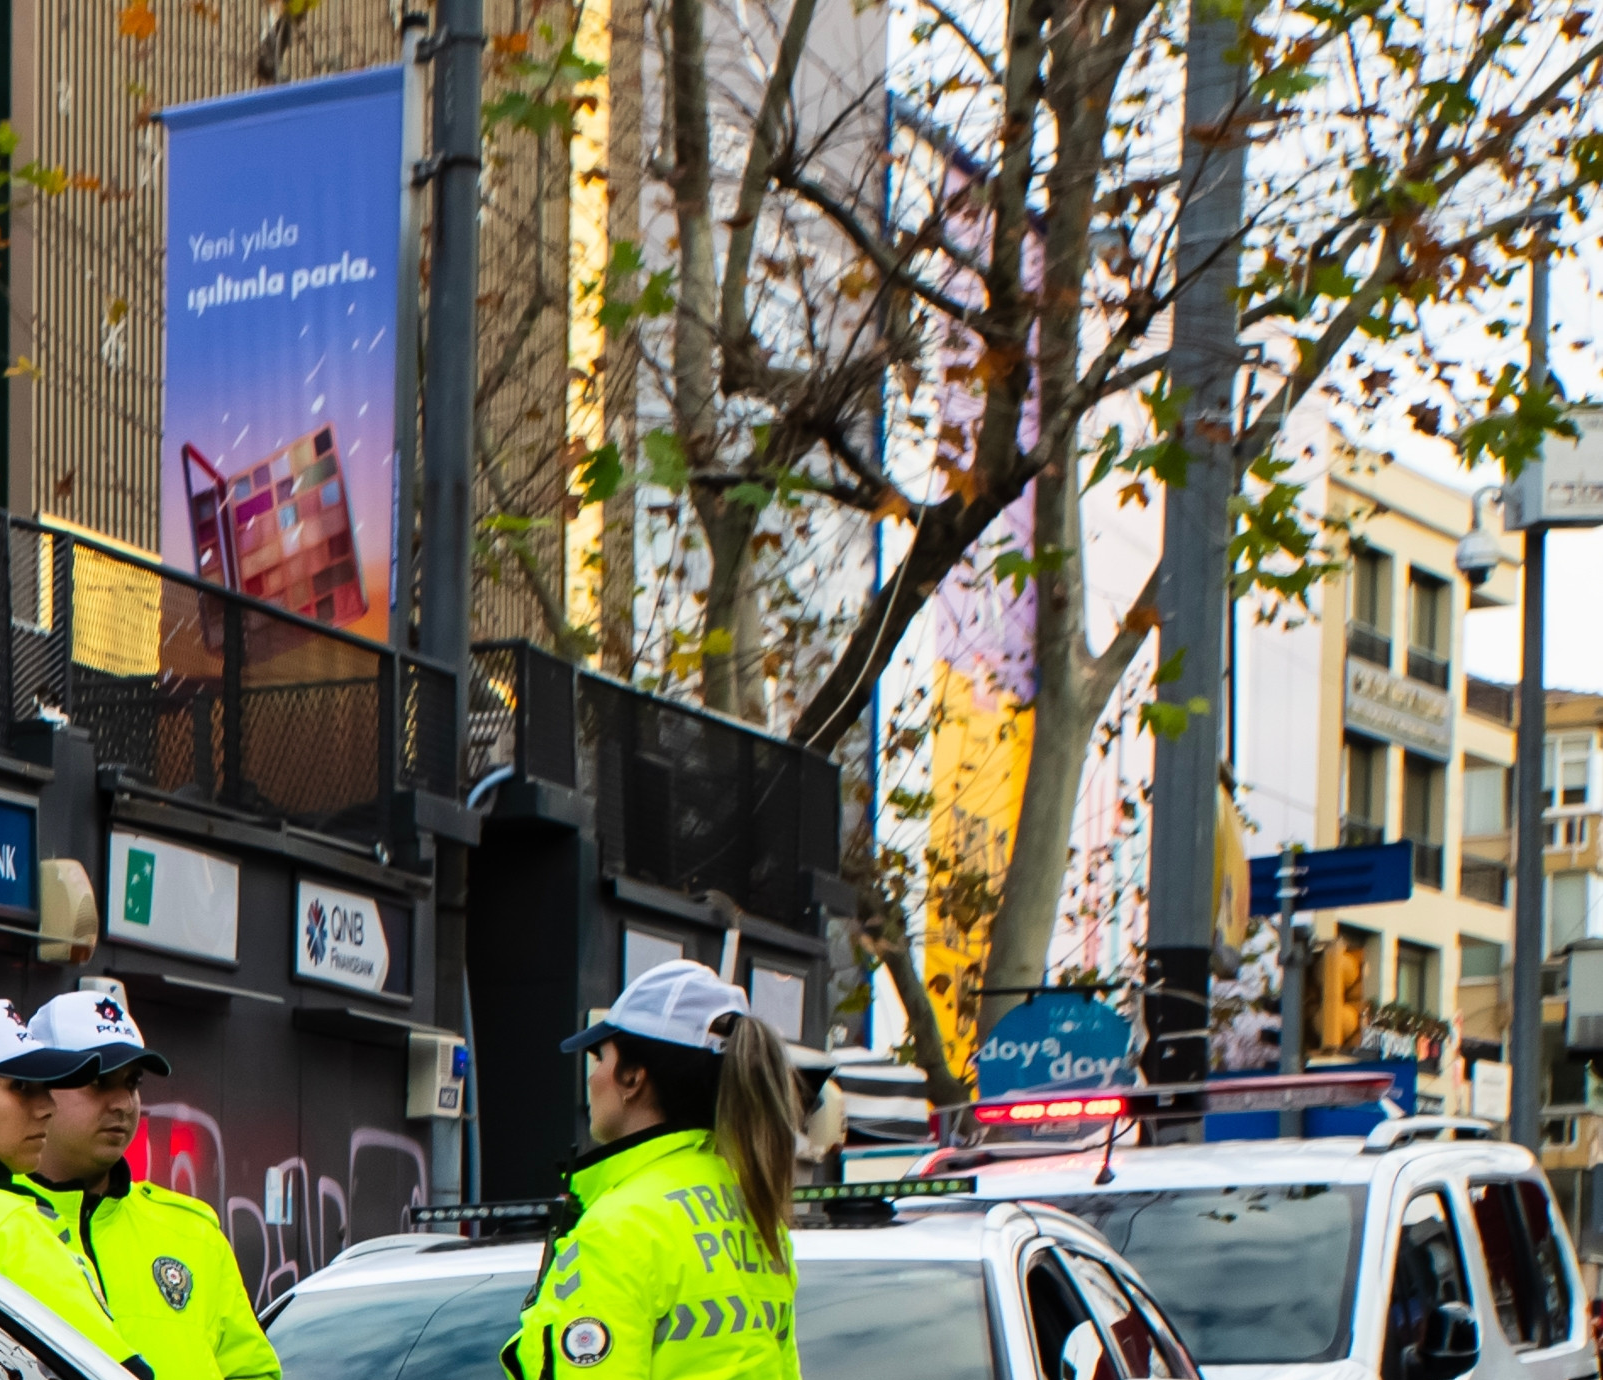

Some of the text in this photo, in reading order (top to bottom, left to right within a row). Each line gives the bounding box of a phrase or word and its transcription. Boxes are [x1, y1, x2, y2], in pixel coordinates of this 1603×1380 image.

[189, 214, 298, 263] Yeni yılda
[292, 251, 377, 301] parla.
[331, 904, 364, 946] QNB
[980, 1037, 1060, 1069] doya
[1049, 1051, 1122, 1089] doy
